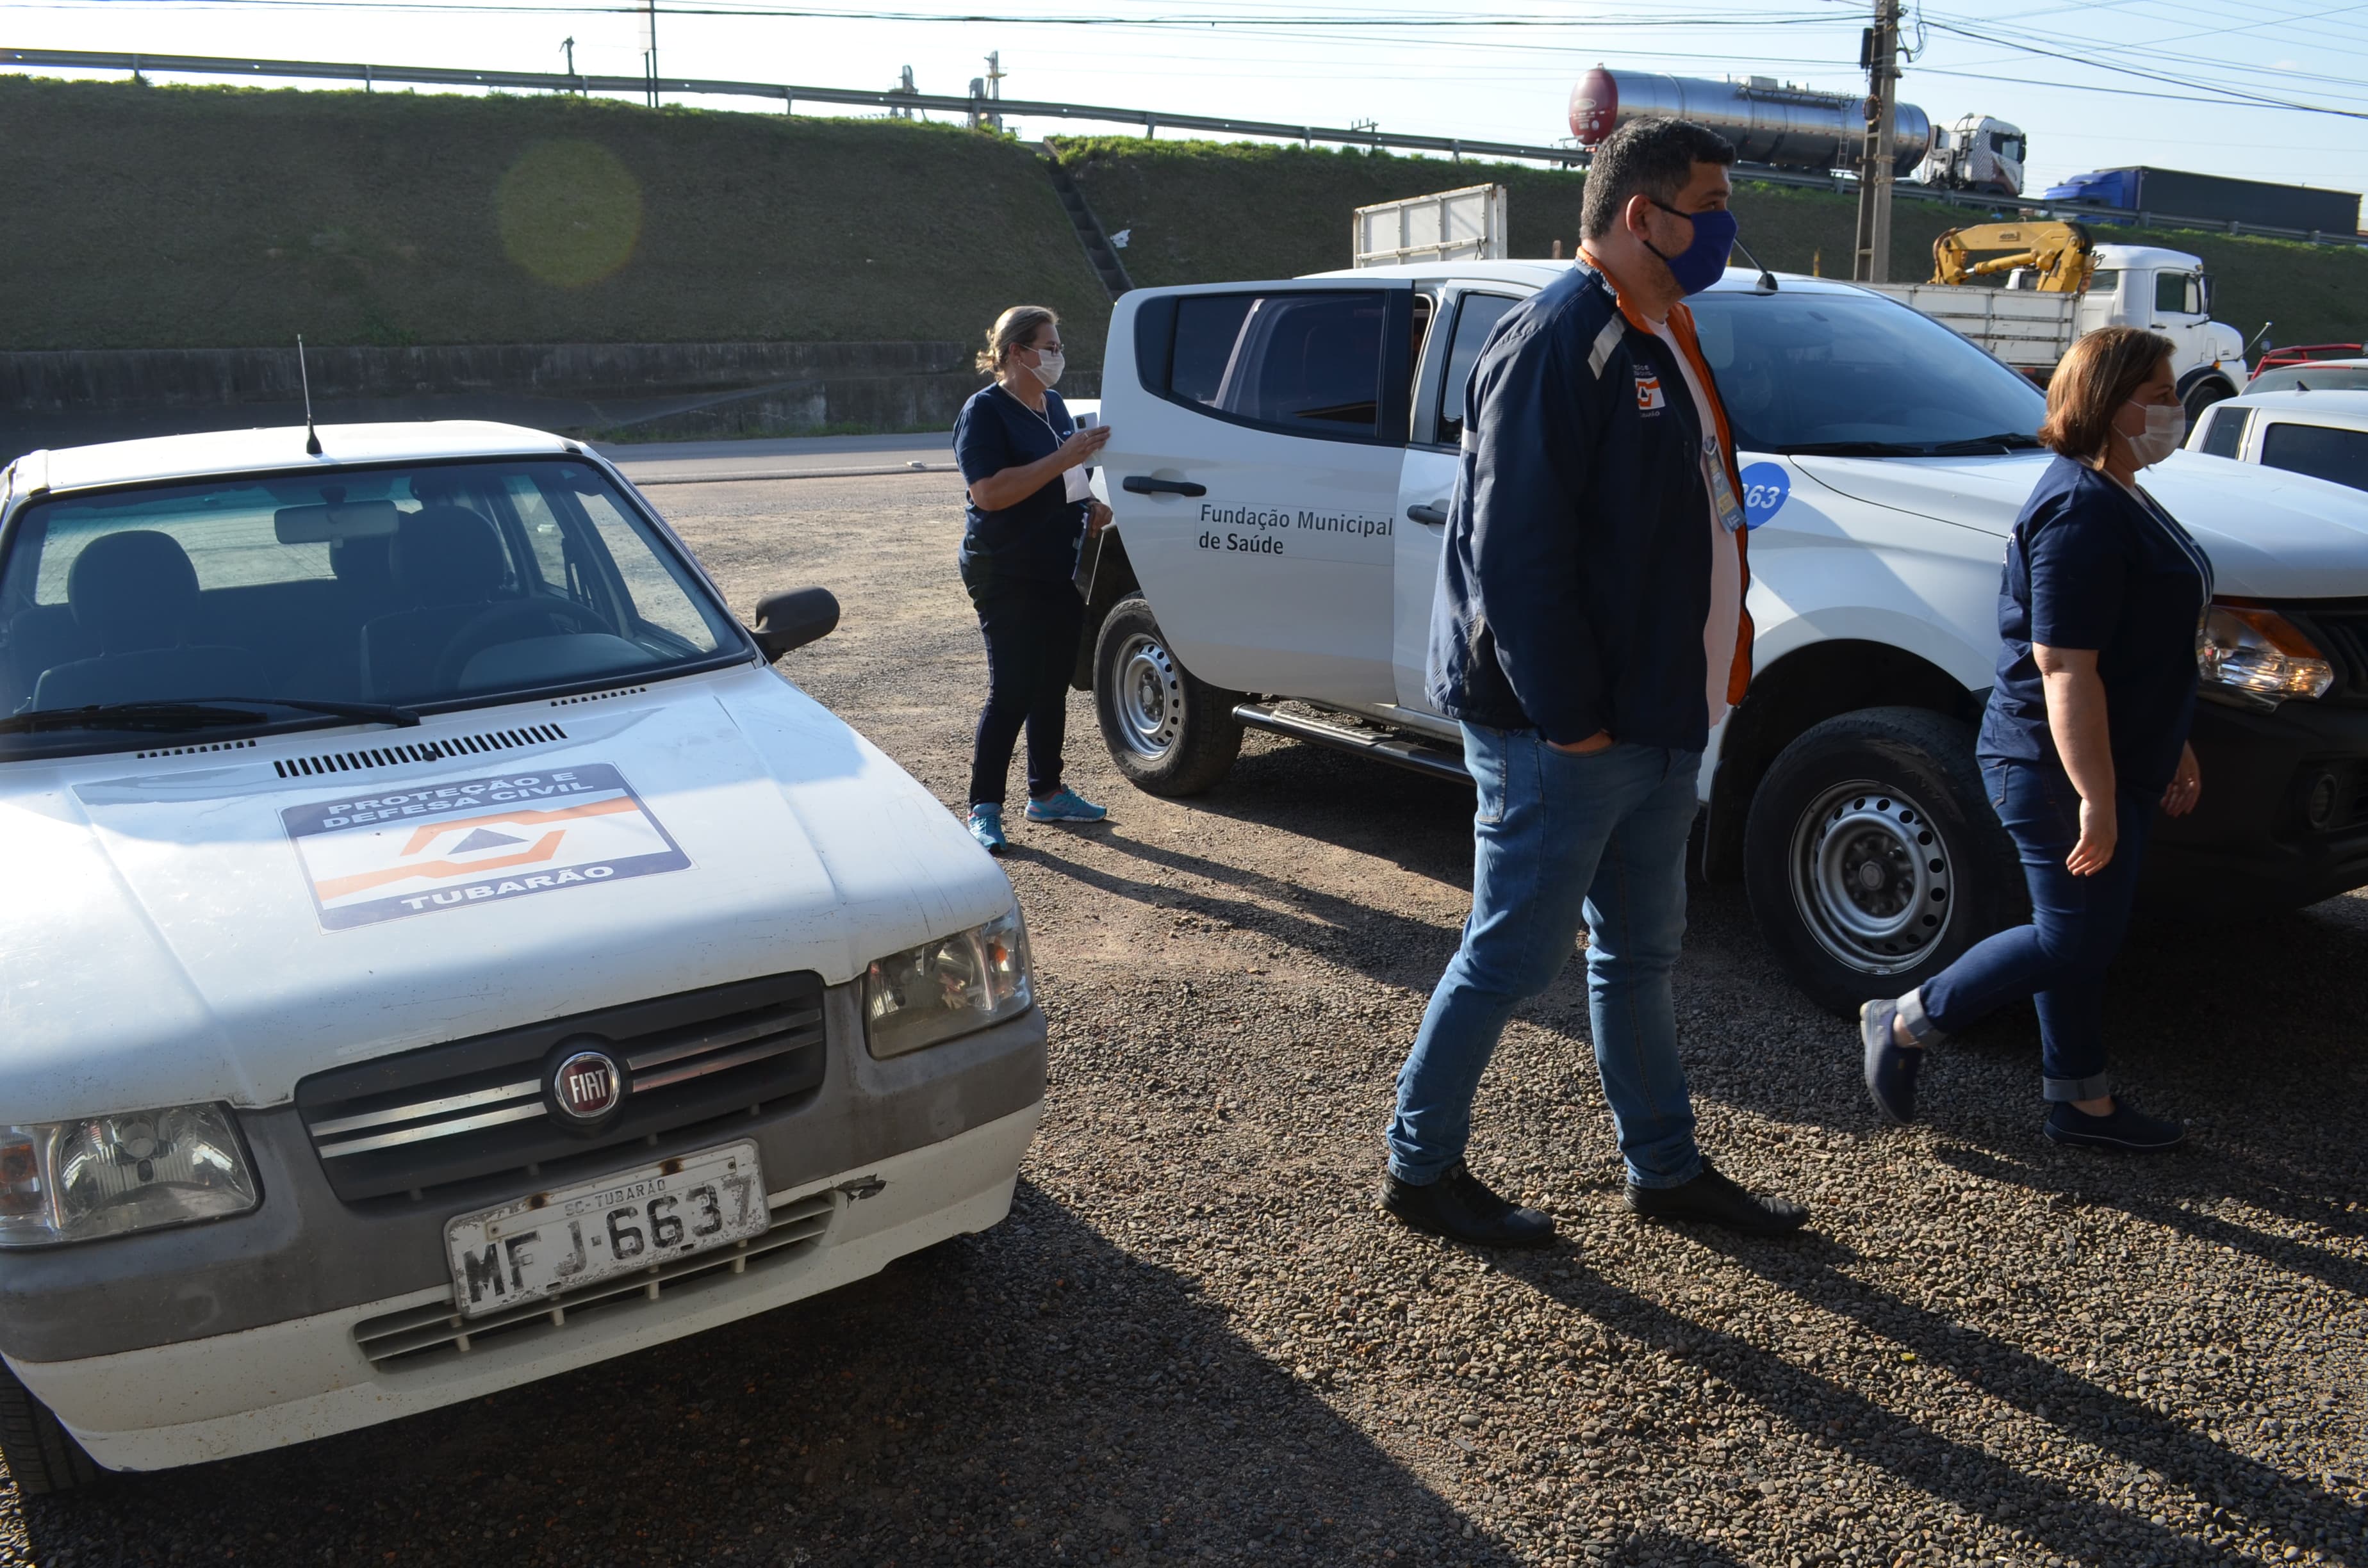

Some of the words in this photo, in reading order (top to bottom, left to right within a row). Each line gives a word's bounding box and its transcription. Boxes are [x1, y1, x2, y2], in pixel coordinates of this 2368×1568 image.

[1200, 504, 1290, 531] Fundação
[1297, 510, 1394, 537] Municipal
[1199, 531, 1221, 550] de
[1226, 533, 1284, 555] Saúde
[322, 796, 481, 829] DEFESA
[491, 783, 594, 801] CIVIL
[327, 777, 540, 815] PROTEÇÃO
[552, 772, 577, 783] E
[400, 865, 615, 910] TUBARÃO
[569, 1068, 607, 1104] FIAT
